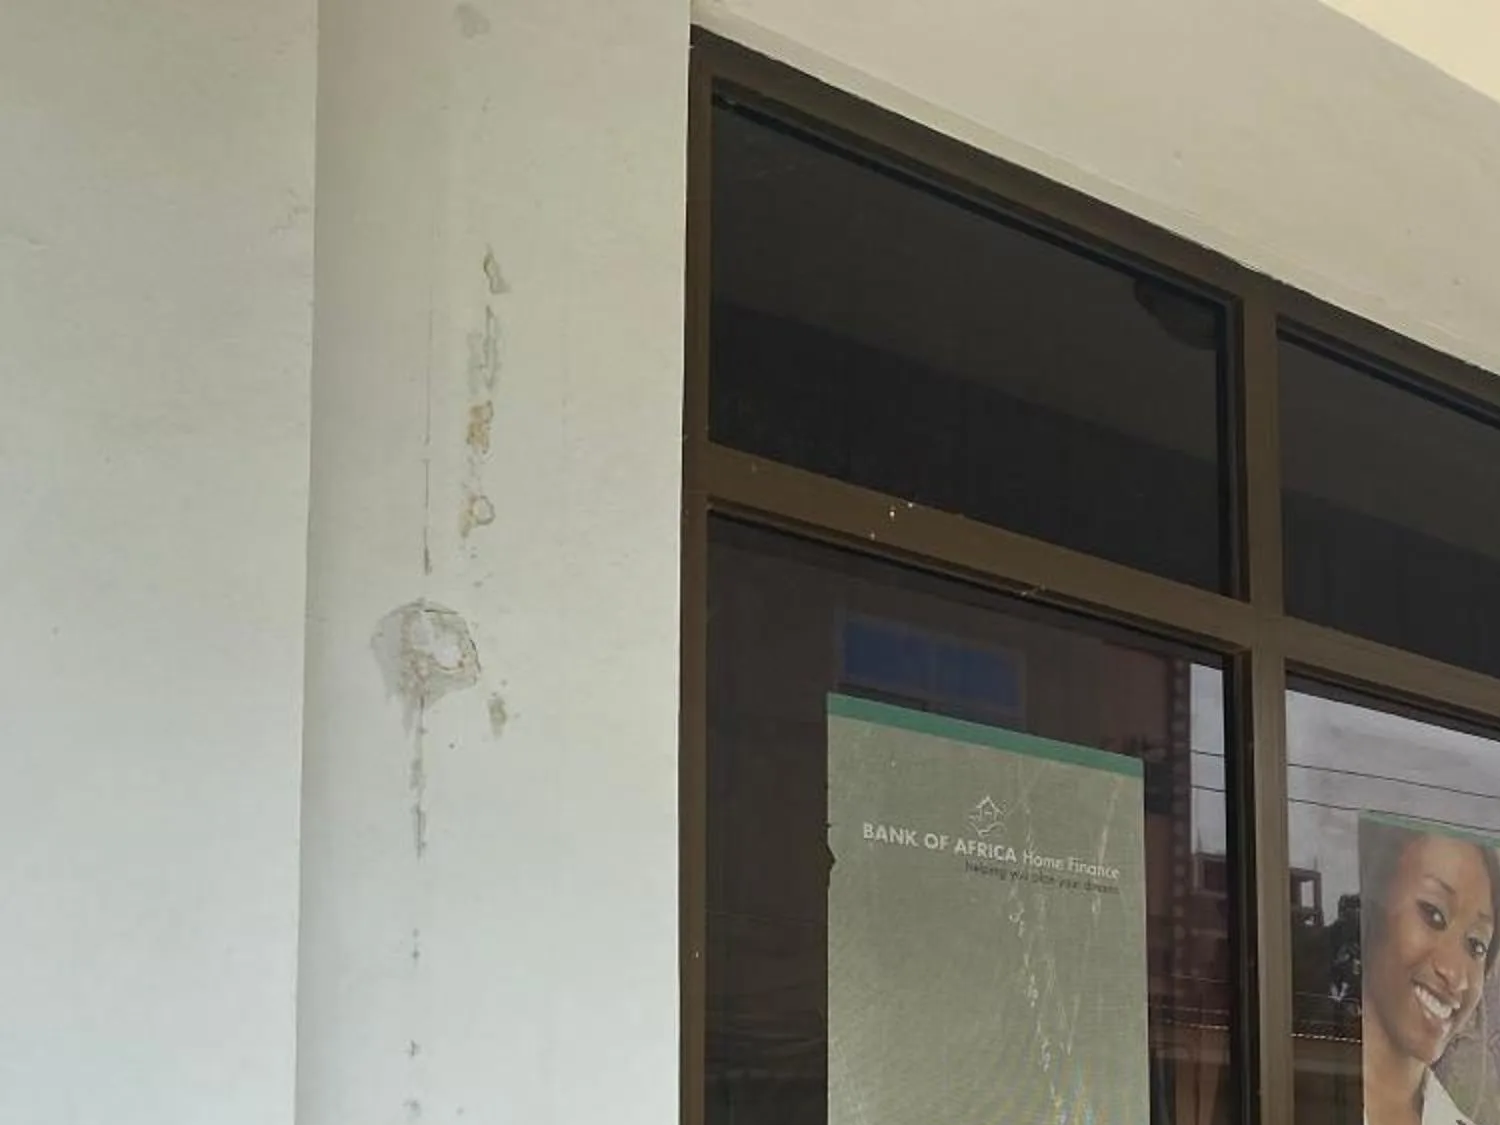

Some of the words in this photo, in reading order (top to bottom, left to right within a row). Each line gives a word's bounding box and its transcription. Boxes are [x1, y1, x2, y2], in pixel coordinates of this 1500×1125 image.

[863, 822, 919, 847] BANK
[924, 832, 950, 850] OF
[954, 838, 1017, 863] AFRICA
[1023, 850, 1065, 872] Home
[1067, 857, 1121, 880] Finance
